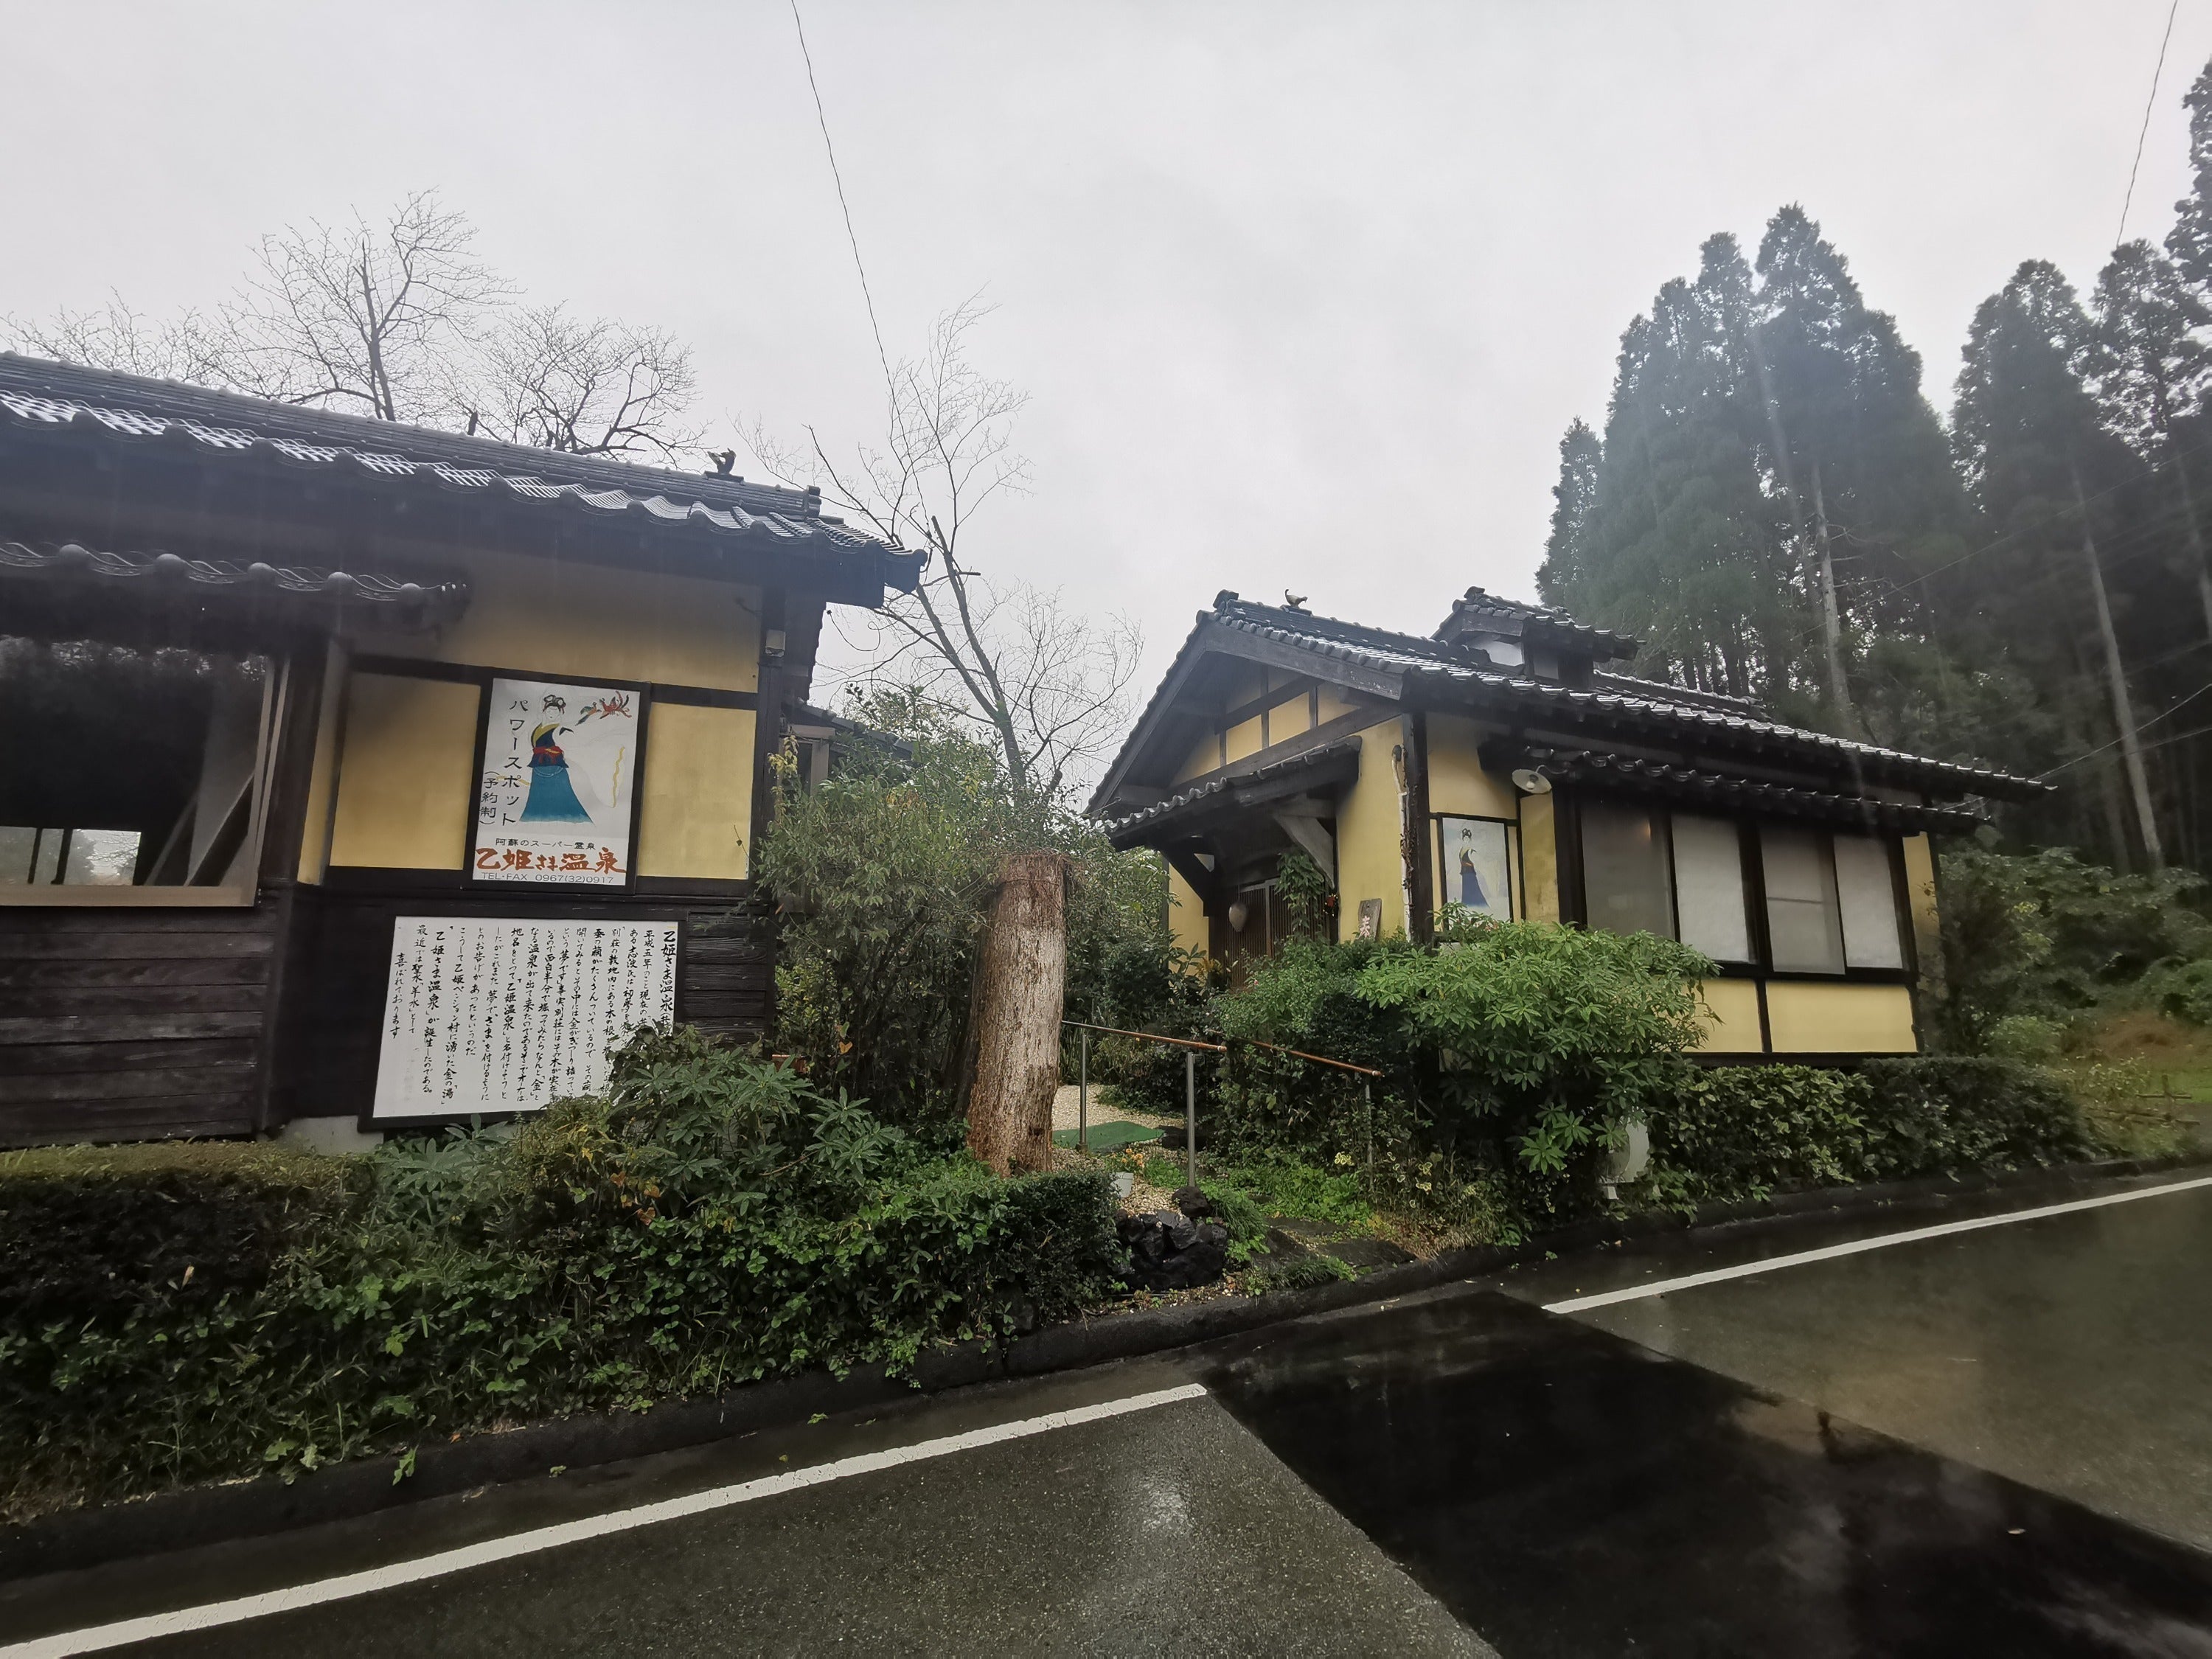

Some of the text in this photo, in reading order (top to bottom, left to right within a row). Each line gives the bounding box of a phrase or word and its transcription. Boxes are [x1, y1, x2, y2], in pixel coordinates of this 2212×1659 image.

[501, 699, 529, 827] パワースポット
[476, 846, 627, 874] 乙姫さま温泉
[535, 873, 614, 884] 0967(32)0917
